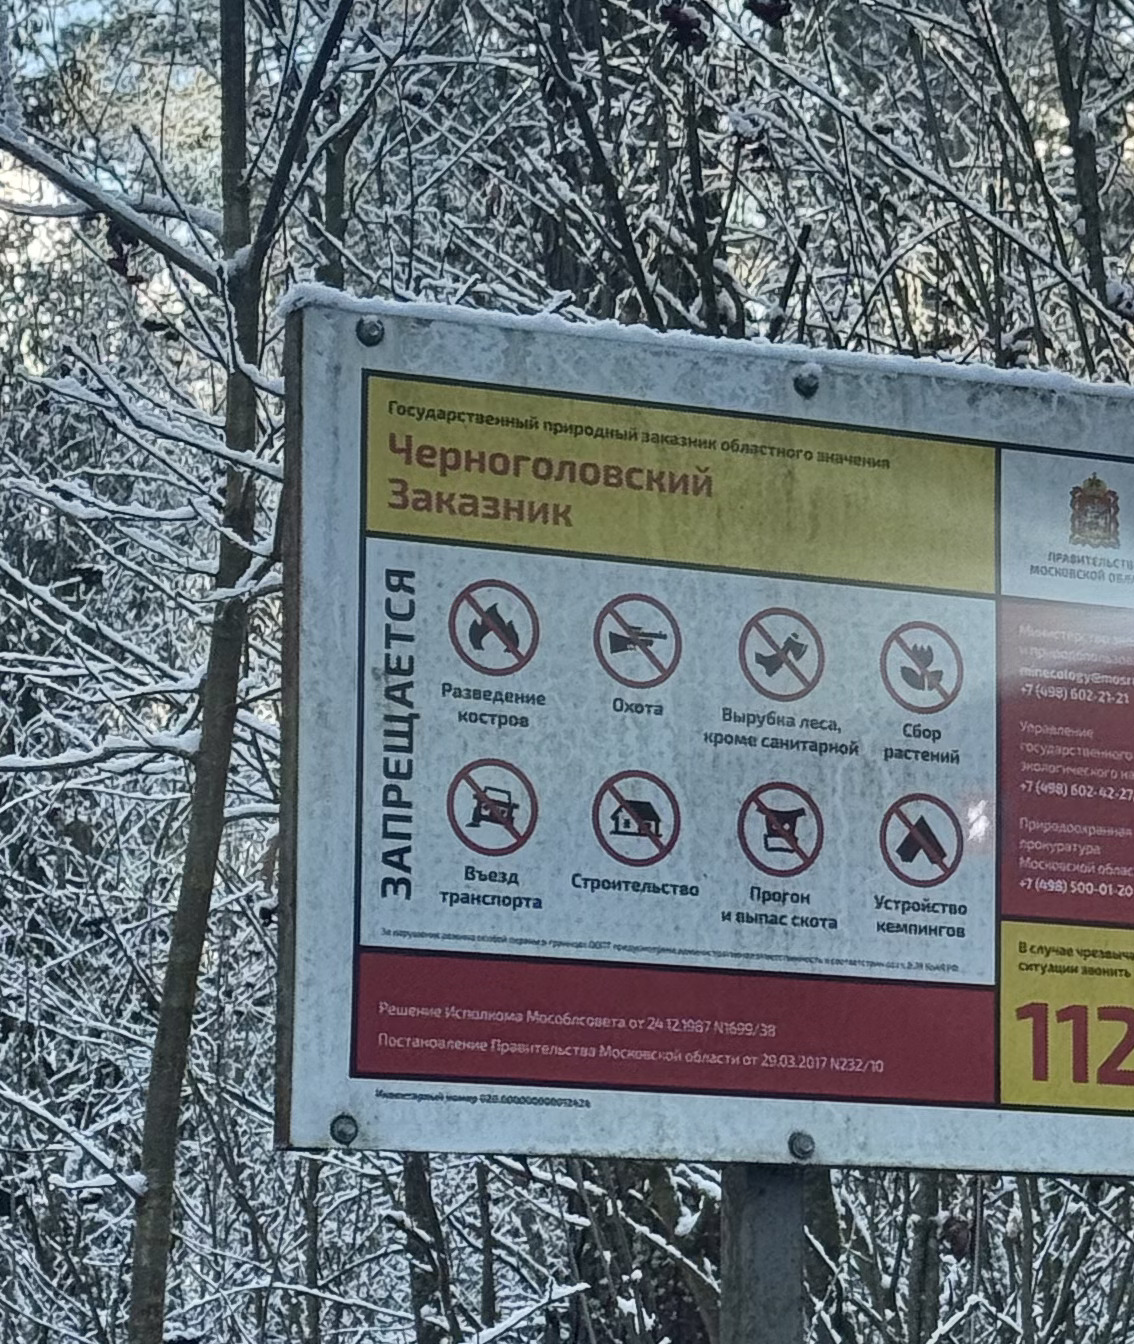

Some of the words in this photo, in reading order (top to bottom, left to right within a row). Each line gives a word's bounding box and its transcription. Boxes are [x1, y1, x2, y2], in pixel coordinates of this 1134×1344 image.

[388, 400, 539, 431] Государственный
[542, 419, 638, 442] природный
[641, 430, 717, 451] заказник
[720, 438, 813, 461] областного
[816, 451, 891, 470] значения
[388, 432, 713, 498] Черноголовский
[387, 477, 573, 527] Заказник
[1029, 564, 1105, 582] МОСКОВСКОЙ
[441, 682, 546, 707] Разведение
[1070, 687, 1130, 705] 602-21-21
[612, 697, 664, 716] Охота
[458, 709, 530, 729] костров
[721, 707, 795, 729] Вырубка
[799, 715, 842, 734] леса,
[1020, 720, 1094, 739] Управление
[381, 568, 420, 900] ЗАПРЕЩАЕТСЯ
[902, 722, 942, 742] Сбор
[703, 730, 758, 748] кроме
[761, 734, 860, 757] санитарной
[1020, 742, 1134, 762] государственного
[883, 744, 960, 765] растений
[1020, 780, 1032, 793] +7
[1019, 839, 1102, 856] прокуратура
[464, 865, 520, 886] Въезд
[1019, 856, 1096, 874] Московской
[571, 872, 700, 898] Строительство
[750, 885, 811, 906] Прогон
[1070, 880, 1134, 898] 500-01-20
[439, 890, 543, 911] транспорта
[873, 894, 968, 917] Устройство
[720, 909, 731, 922] и
[736, 910, 787, 927] выпас
[791, 914, 838, 930] скота
[876, 919, 966, 939] кемпингов
[1018, 940, 1027, 954] В
[1029, 943, 1074, 959] случае
[1018, 961, 1079, 976] ситуации
[1081, 968, 1132, 979] звонить
[378, 1000, 442, 1019] Решение
[444, 1004, 523, 1023] Исполкома
[526, 1009, 626, 1029] Мособлсовета
[628, 1018, 644, 1030] от
[378, 1032, 488, 1052] Постановление
[490, 1038, 597, 1059] Правительства
[600, 1044, 682, 1063] Московской
[685, 1048, 740, 1066] области
[743, 1056, 758, 1066] от
[761, 1051, 828, 1070] 29.03.2017
